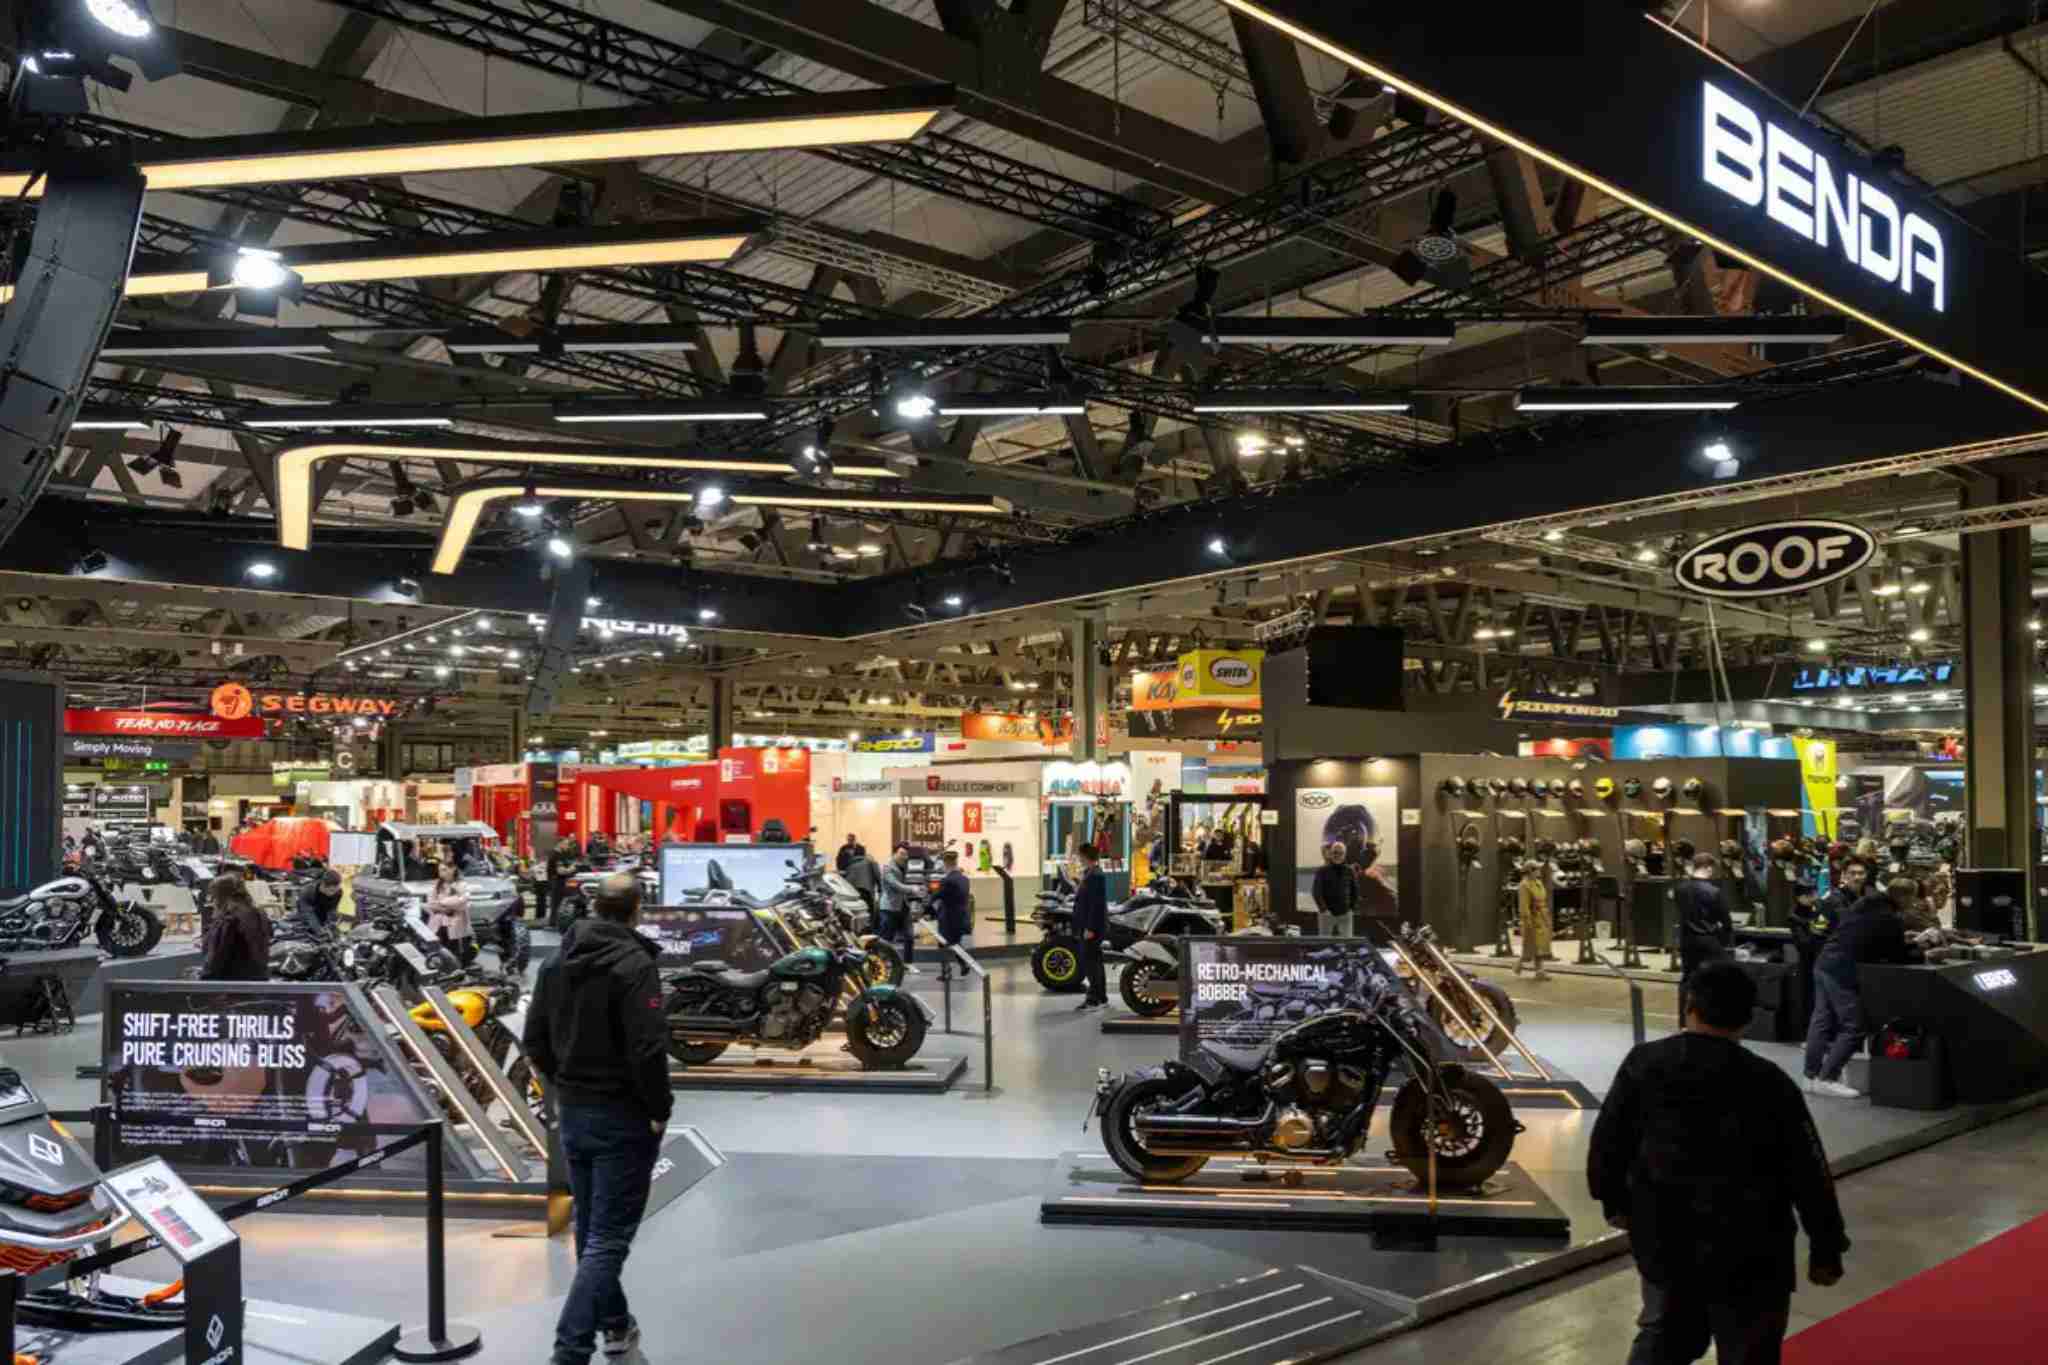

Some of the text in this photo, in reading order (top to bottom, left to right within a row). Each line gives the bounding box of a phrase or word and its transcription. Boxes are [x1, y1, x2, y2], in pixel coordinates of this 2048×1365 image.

[1703, 80, 1945, 313] BENDA
[1693, 535, 1852, 585] ROOF
[261, 695, 396, 714] SEGWAY
[73, 740, 153, 756] Simply Moving
[1197, 963, 1329, 982] RETRO-MECHANICAL
[1198, 984, 1248, 1001] BOBBER
[123, 1012, 294, 1039] SHIFT-FREE THRILLS
[121, 1041, 307, 1069] PURE CRUISING BLISS
